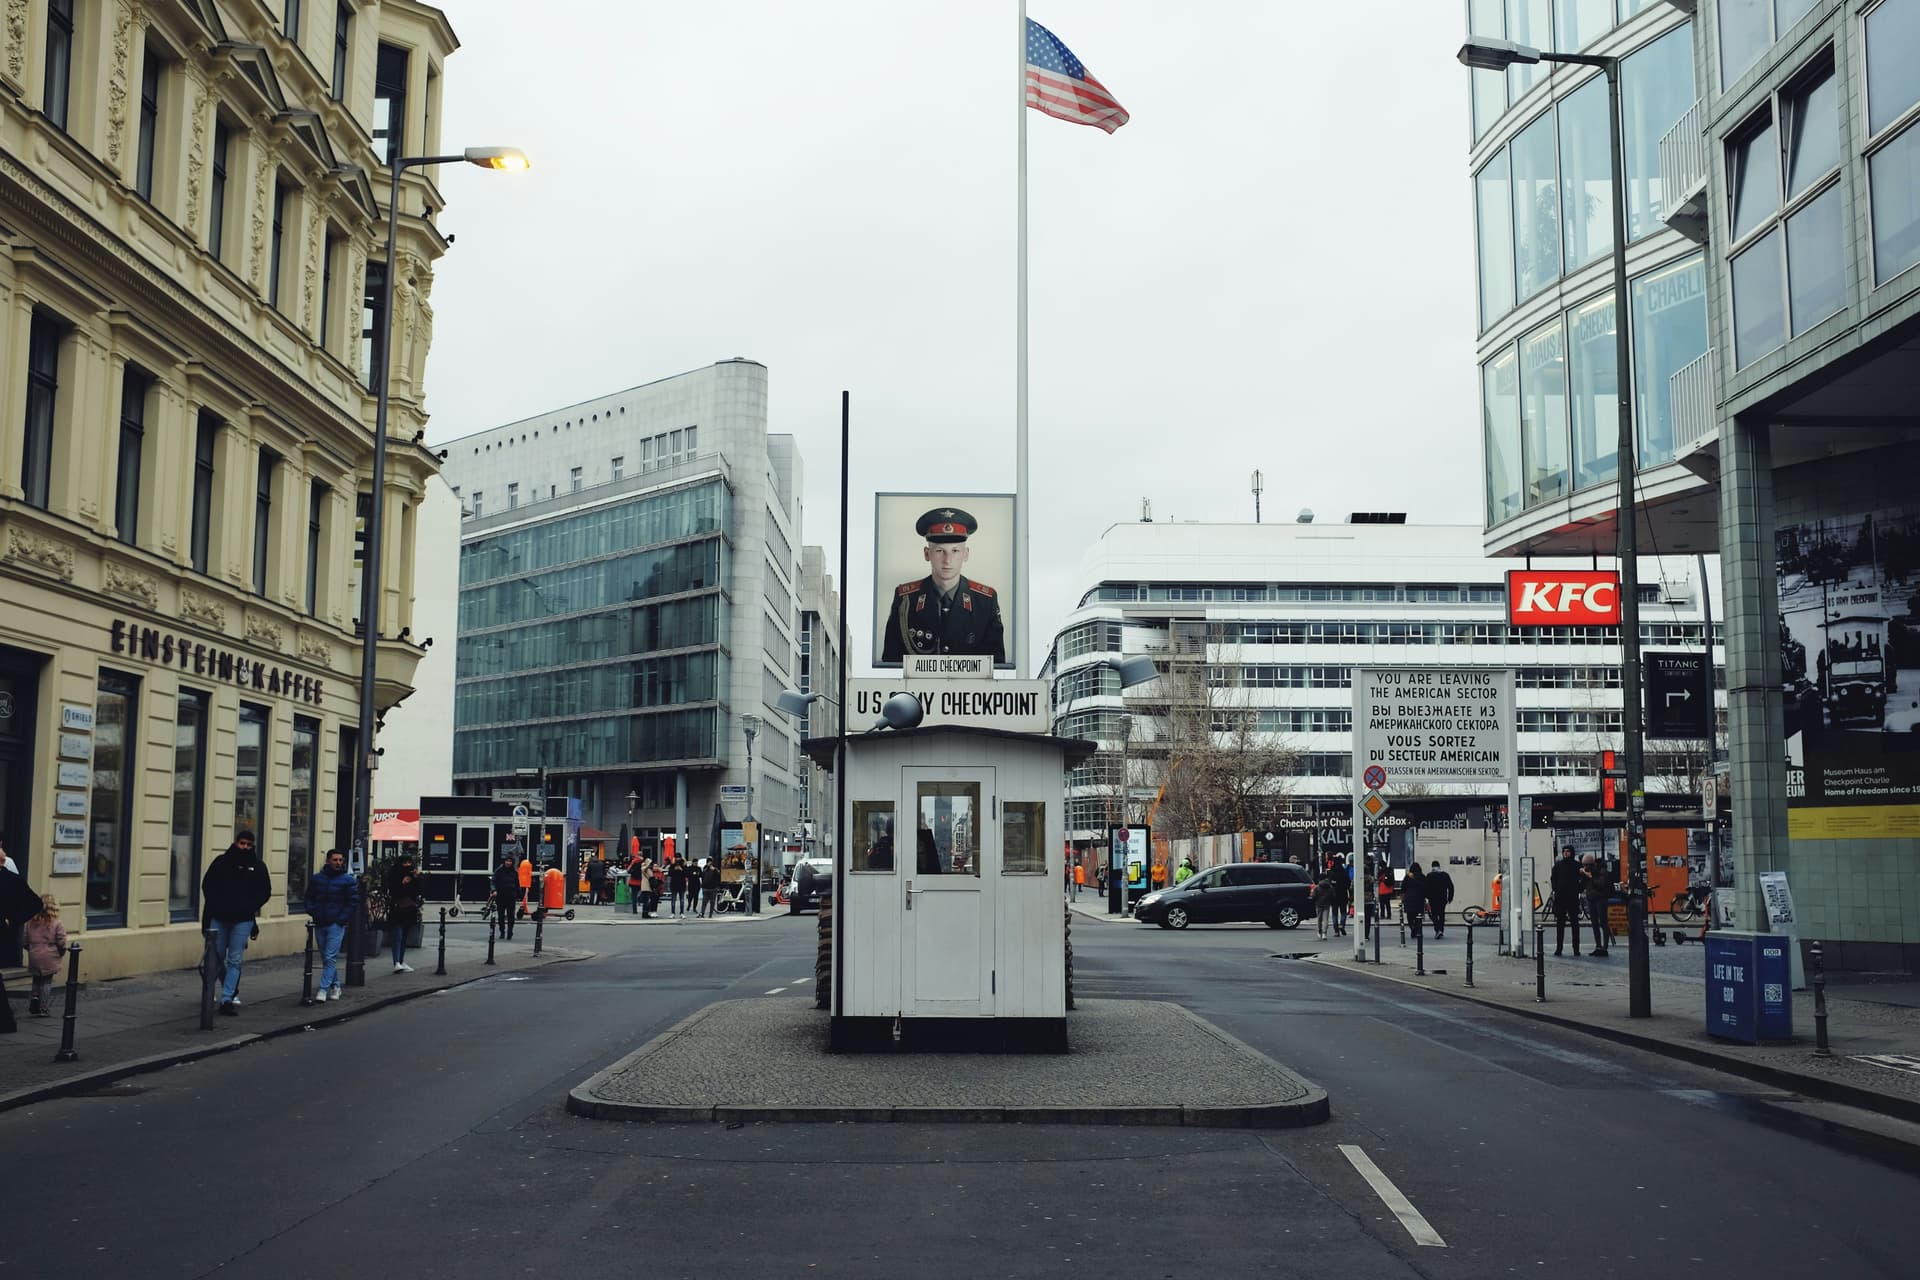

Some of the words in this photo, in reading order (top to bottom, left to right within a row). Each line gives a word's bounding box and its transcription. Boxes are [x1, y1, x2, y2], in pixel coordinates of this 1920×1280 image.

[1515, 582, 1616, 613] KFC
[111, 618, 233, 681] EINSTEIN
[252, 661, 324, 705] KAFFEE
[915, 659, 938, 673] ALLIED
[940, 659, 982, 673] CHECKPOINT
[1658, 660, 1699, 669] TITANIC
[1376, 673, 1401, 685] YOU
[1408, 673, 1432, 685] ARE
[1440, 673, 1491, 685] LEAVING
[1370, 687, 1389, 698] THE
[1395, 687, 1451, 699] AMERICAN
[1457, 688, 1498, 699] SECTOR
[857, 691, 868, 714] U
[872, 691, 882, 714] S
[941, 692, 1039, 716] CHECKPOINT
[1372, 705, 1391, 717] ВЫ
[1398, 705, 1472, 717] ВЫЕЗЖАЕТЕ
[1480, 705, 1496, 717] ИЗ
[1369, 718, 1453, 730] АМЕРИКАНСКОГО
[1456, 719, 1499, 731] СЕКТОРА
[1387, 735, 1422, 747] VOUS
[1428, 735, 1476, 748] SORTEZ
[1370, 750, 1384, 761] DU
[1388, 750, 1437, 762] SECTEUR
[1384, 766, 1413, 776] ERLASSEN
[1414, 767, 1426, 776] DEN
[1427, 767, 1477, 776] AMERIKANISCHEN
[1478, 767, 1500, 776] SEKTOR
[1823, 768, 1853, 777] Museum
[1854, 767, 1872, 776] Haus
[1823, 778, 1864, 787] Checkpoint
[1786, 785, 1806, 797] EUM
[1824, 788, 1846, 796] Home
[1846, 787, 1854, 796] of
[1855, 786, 1889, 795] Freedom
[1889, 786, 1911, 794] since
[1329, 816, 1353, 827] Charl
[1420, 820, 1463, 829] GUERRE
[1713, 963, 1725, 980] LIFE
[1725, 965, 1732, 981] IN
[1733, 966, 1744, 982] THE
